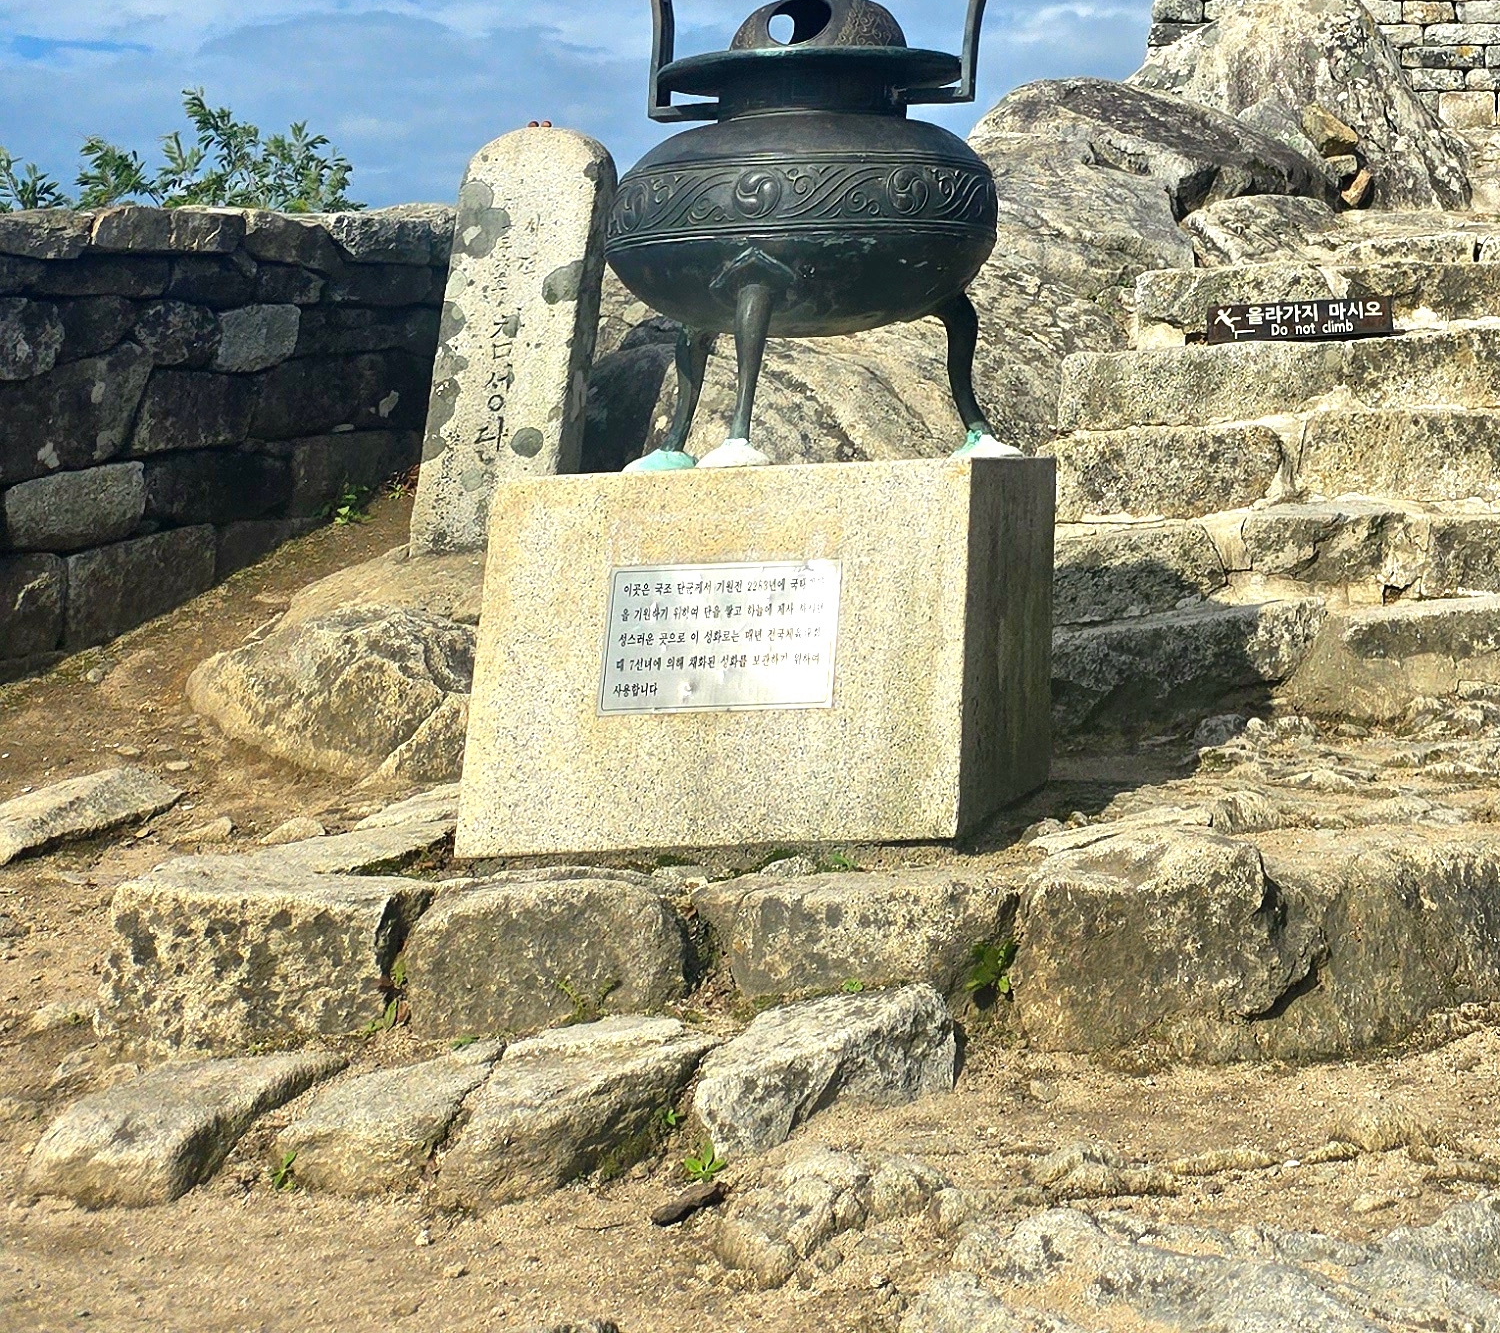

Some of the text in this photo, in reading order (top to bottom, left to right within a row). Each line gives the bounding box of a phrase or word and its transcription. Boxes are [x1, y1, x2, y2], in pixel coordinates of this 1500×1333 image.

[1246, 301, 1383, 325] 올라가지 마시오
[1271, 318, 1354, 336] Do not climb
[623, 583, 650, 597] 이곳은
[655, 583, 672, 595] 국조
[716, 580, 742, 594] 기원전
[621, 608, 630, 622] 을
[634, 606, 668, 621] 기원하기
[673, 605, 698, 620] 위하여
[704, 605, 720, 619] 단을
[725, 604, 741, 618] 쌓고
[747, 603, 772, 617] 하늘에
[777, 602, 793, 615] 제사
[619, 632, 654, 647] 성스러운
[659, 632, 685, 645] 곳으로
[690, 630, 699, 644] 이
[704, 629, 739, 644] 성화로는
[745, 628, 762, 642] 매년
[629, 657, 661, 671] 7선녀에
[666, 656, 684, 670] 의해
[688, 655, 716, 670] 채화된
[720, 654, 747, 668] 성화를
[752, 653, 787, 666] 보관하기
[795, 652, 820, 665] 위하여
[613, 682, 657, 697] 사용합니다
